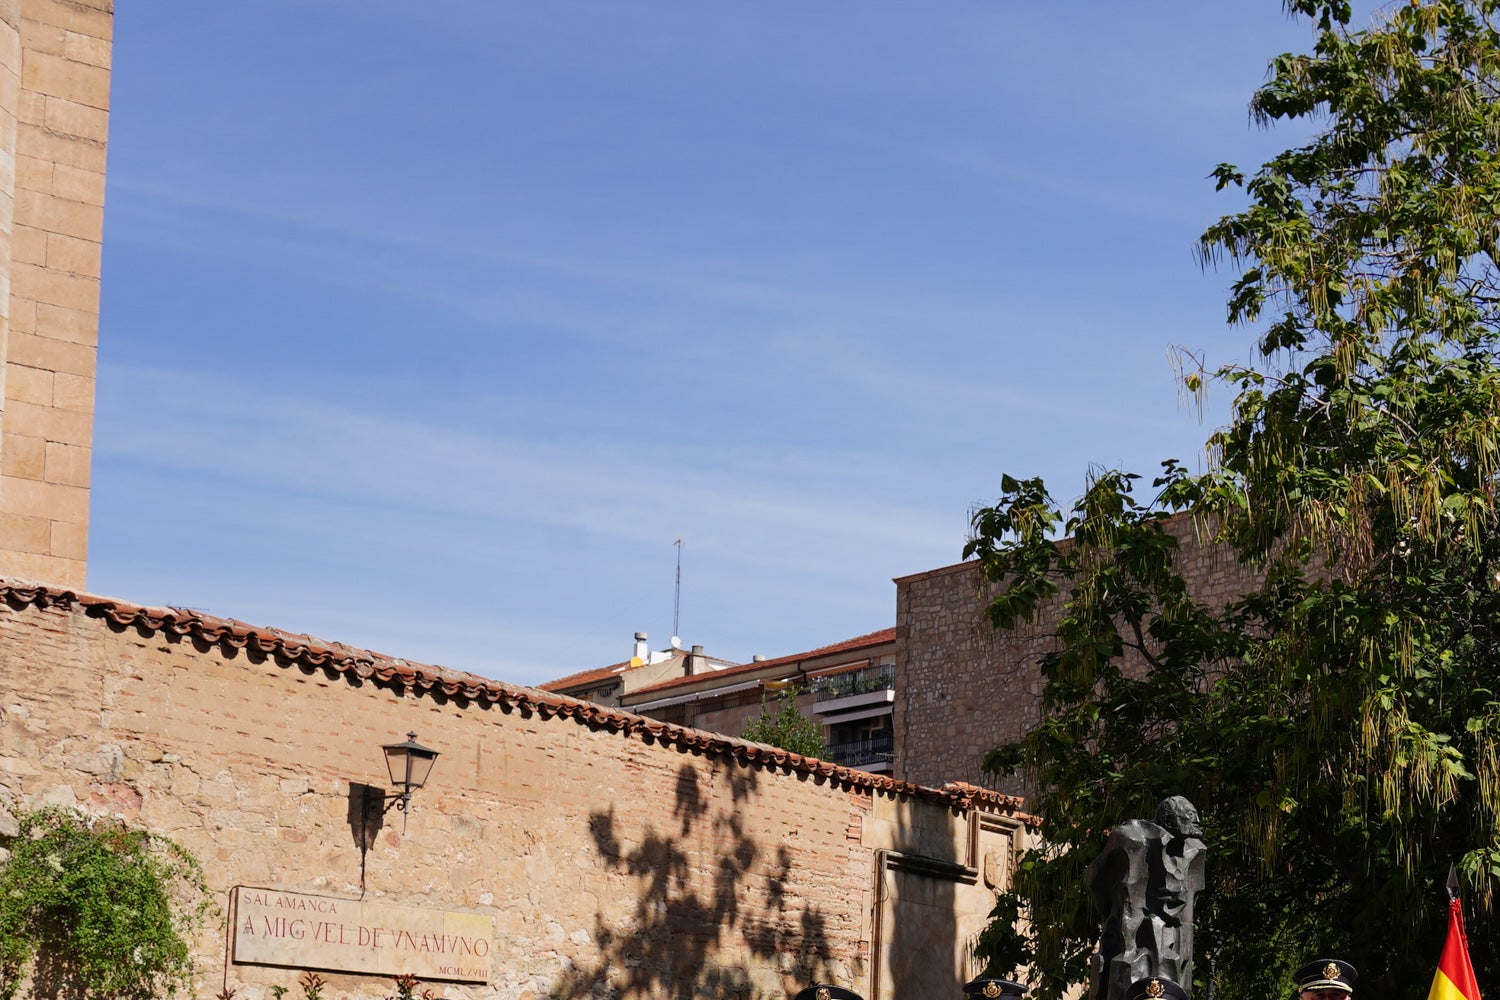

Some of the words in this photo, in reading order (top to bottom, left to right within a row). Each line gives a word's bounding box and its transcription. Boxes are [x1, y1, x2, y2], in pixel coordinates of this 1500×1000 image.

[244, 892, 337, 914] SALAMANCA
[243, 915, 254, 935] A
[263, 916, 350, 945] MIGVEL
[358, 925, 384, 949] DE
[392, 928, 488, 957] VNAMVNO
